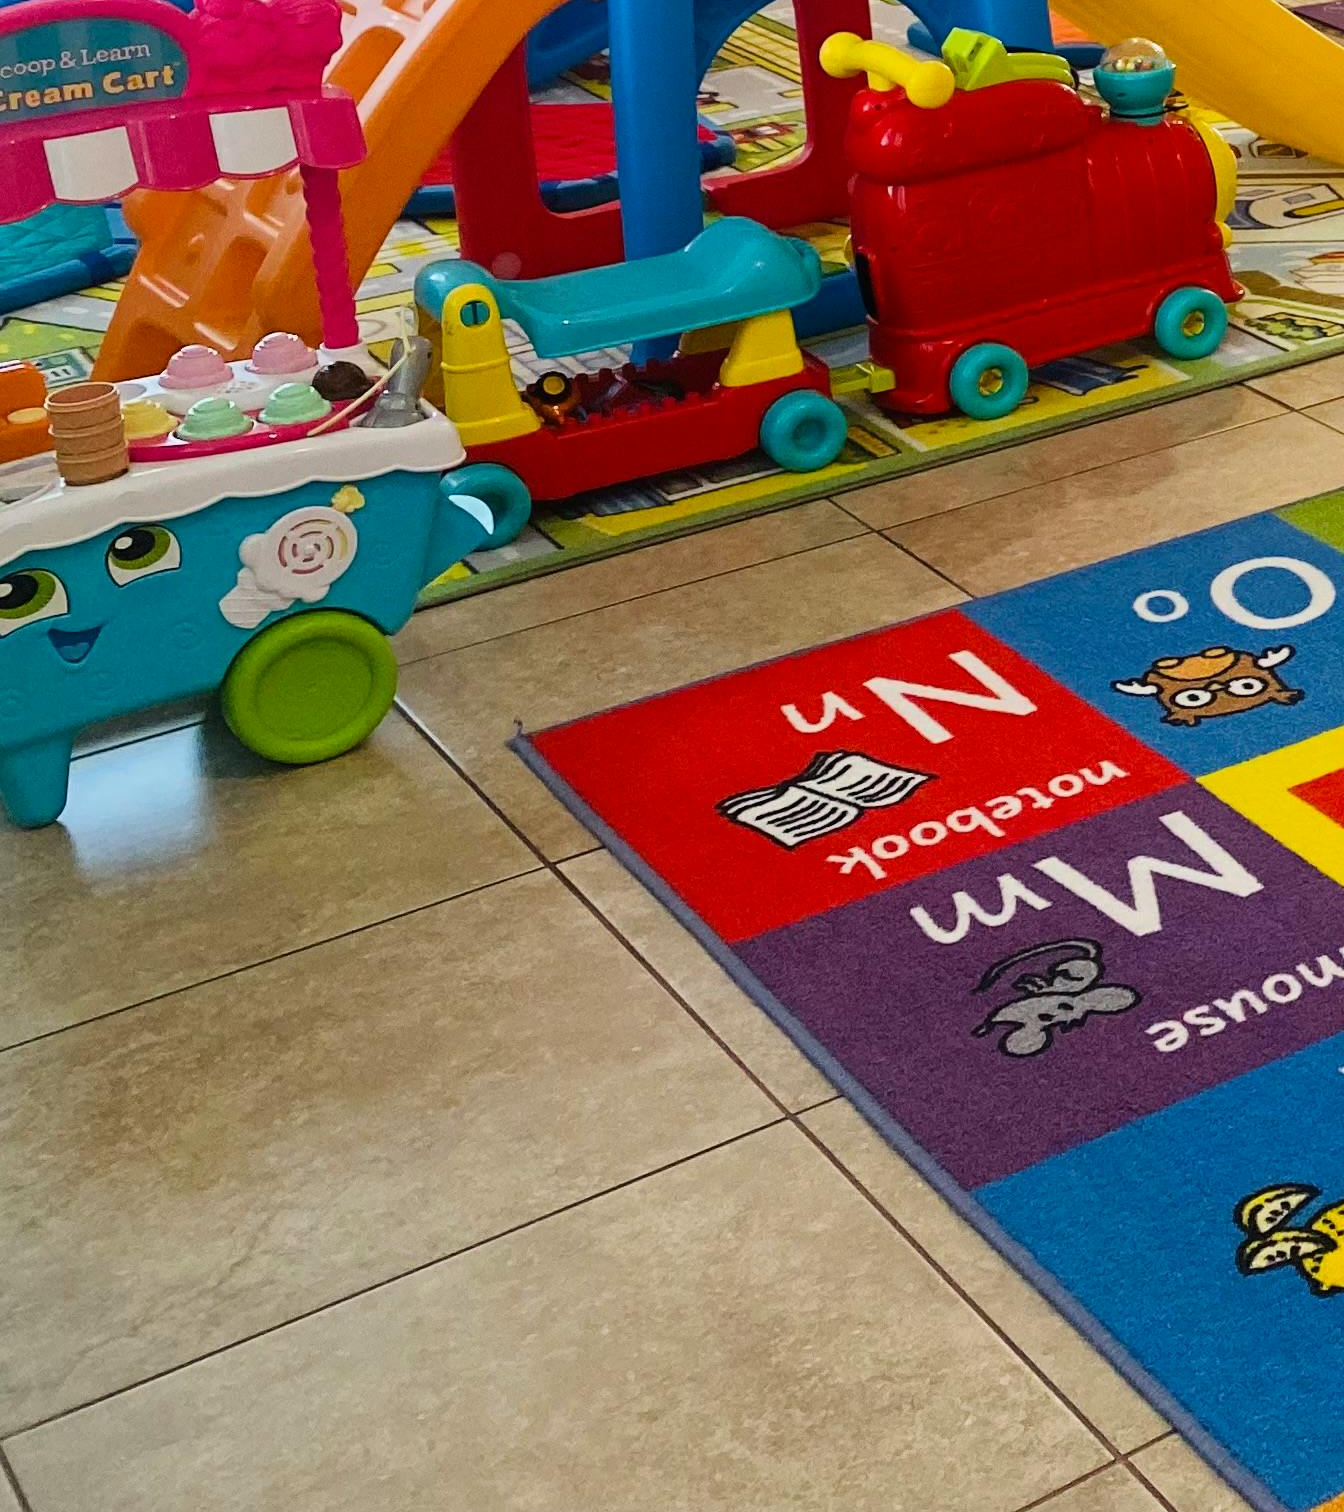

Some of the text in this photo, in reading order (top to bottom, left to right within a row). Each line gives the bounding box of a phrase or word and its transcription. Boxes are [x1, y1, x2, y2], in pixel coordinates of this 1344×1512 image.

[0, 42, 151, 80] coop & Learn
[0, 64, 176, 113] ream Cart
[824, 756, 1131, 886] notebook
